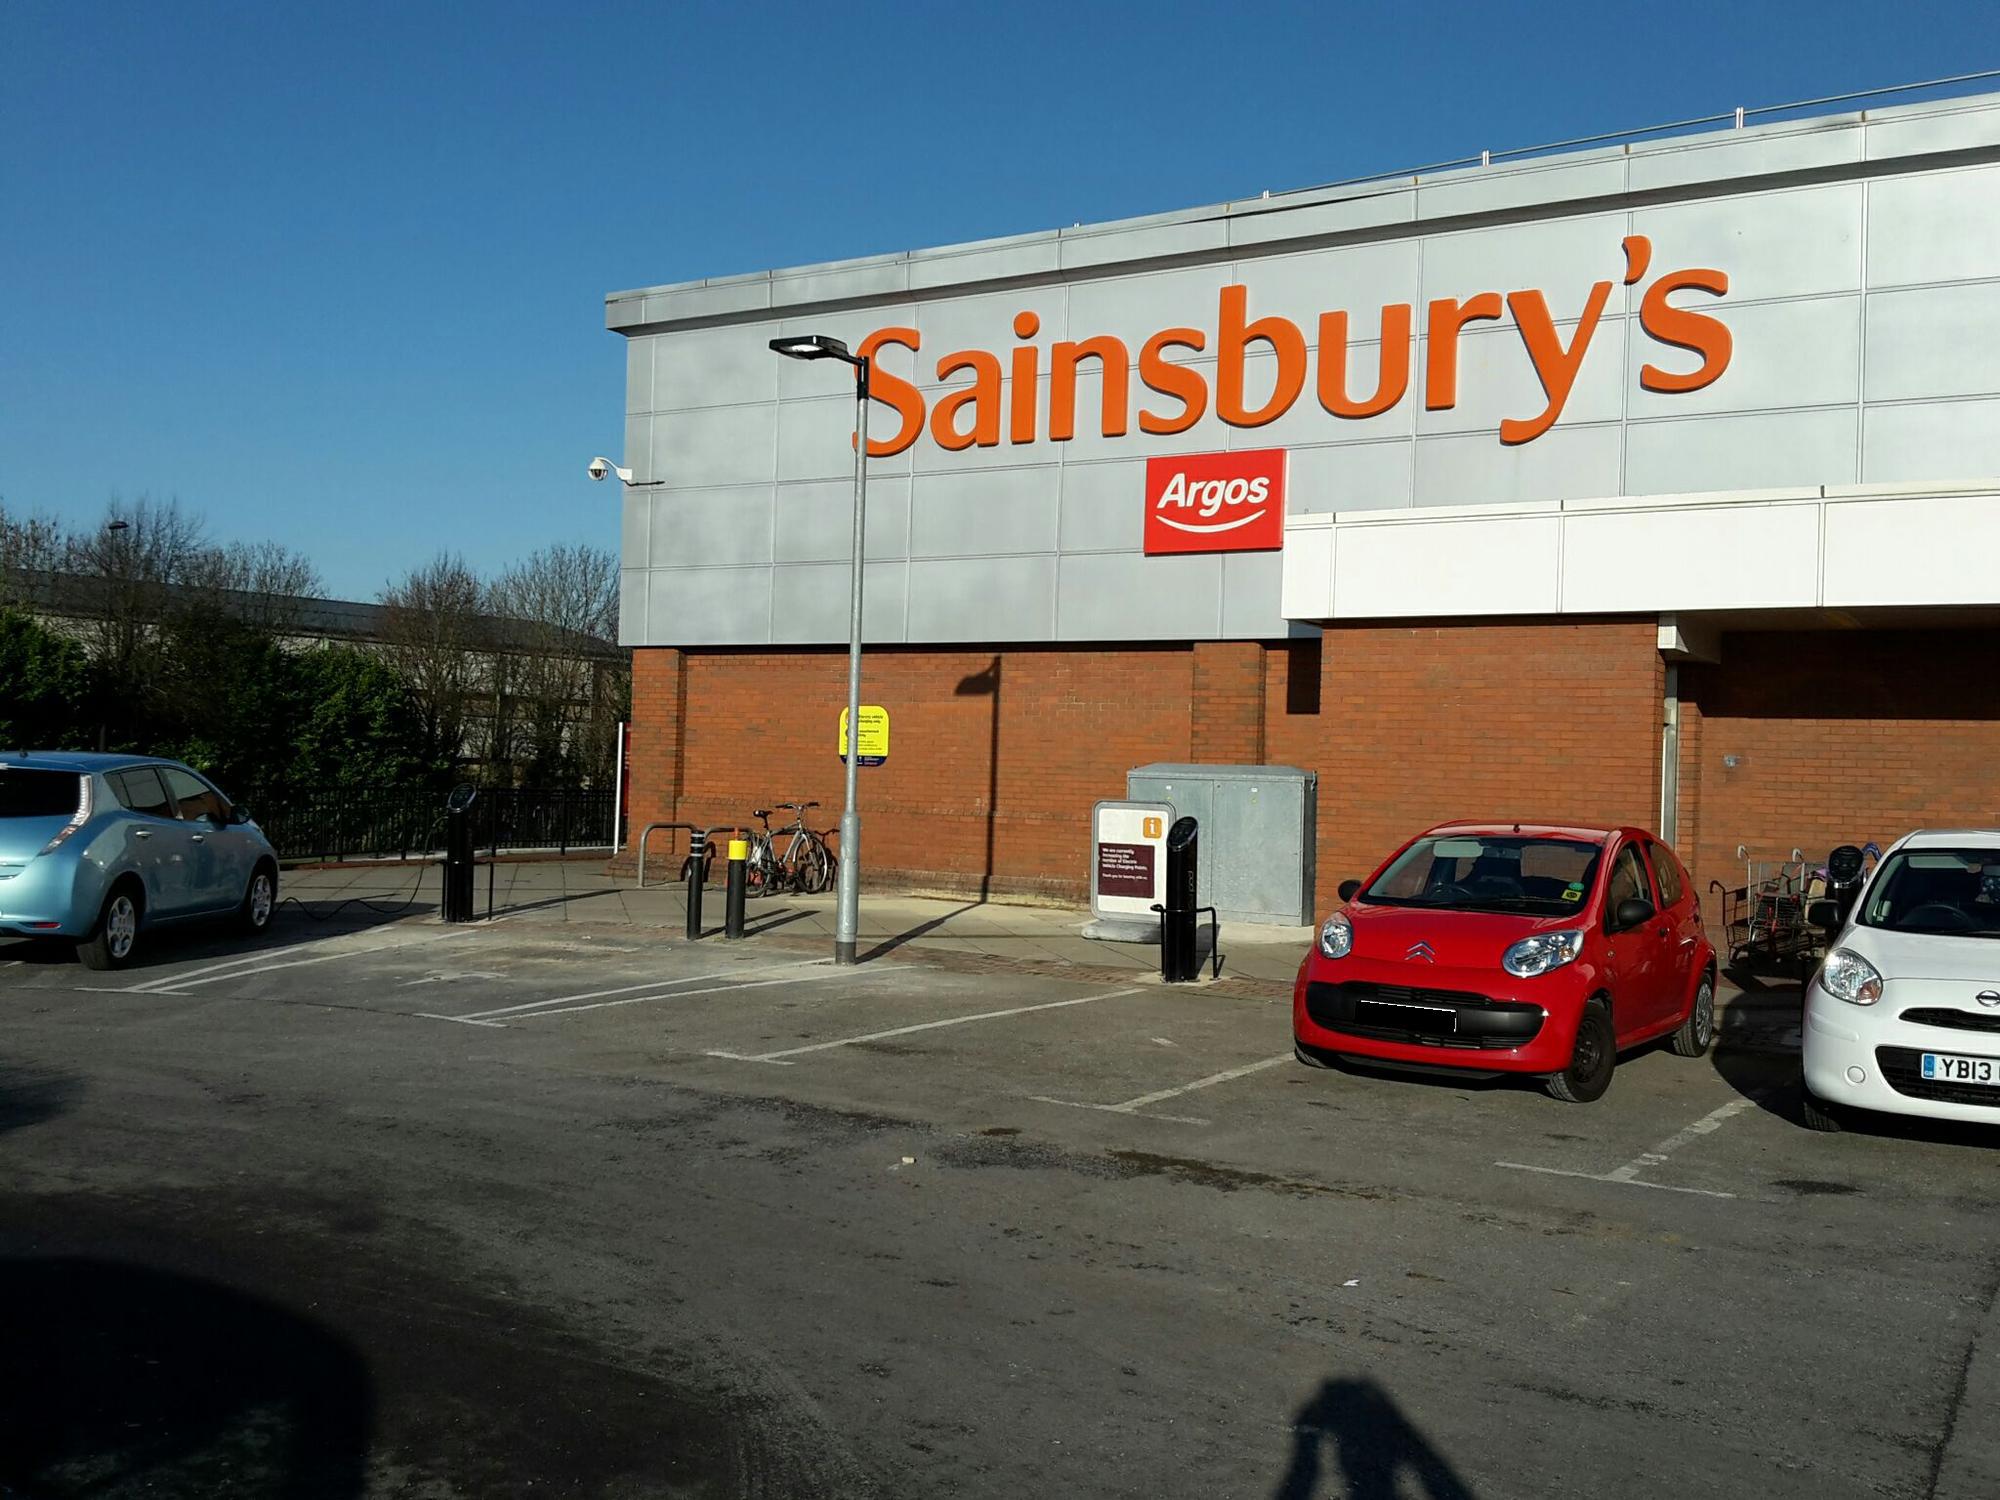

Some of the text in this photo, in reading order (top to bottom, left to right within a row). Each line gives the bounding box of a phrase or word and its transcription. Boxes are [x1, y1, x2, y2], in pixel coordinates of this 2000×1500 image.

[852, 235, 1734, 457] Sainsbury's
[1156, 472, 1270, 517] Argos
[1941, 1059, 1992, 1081] YB13
